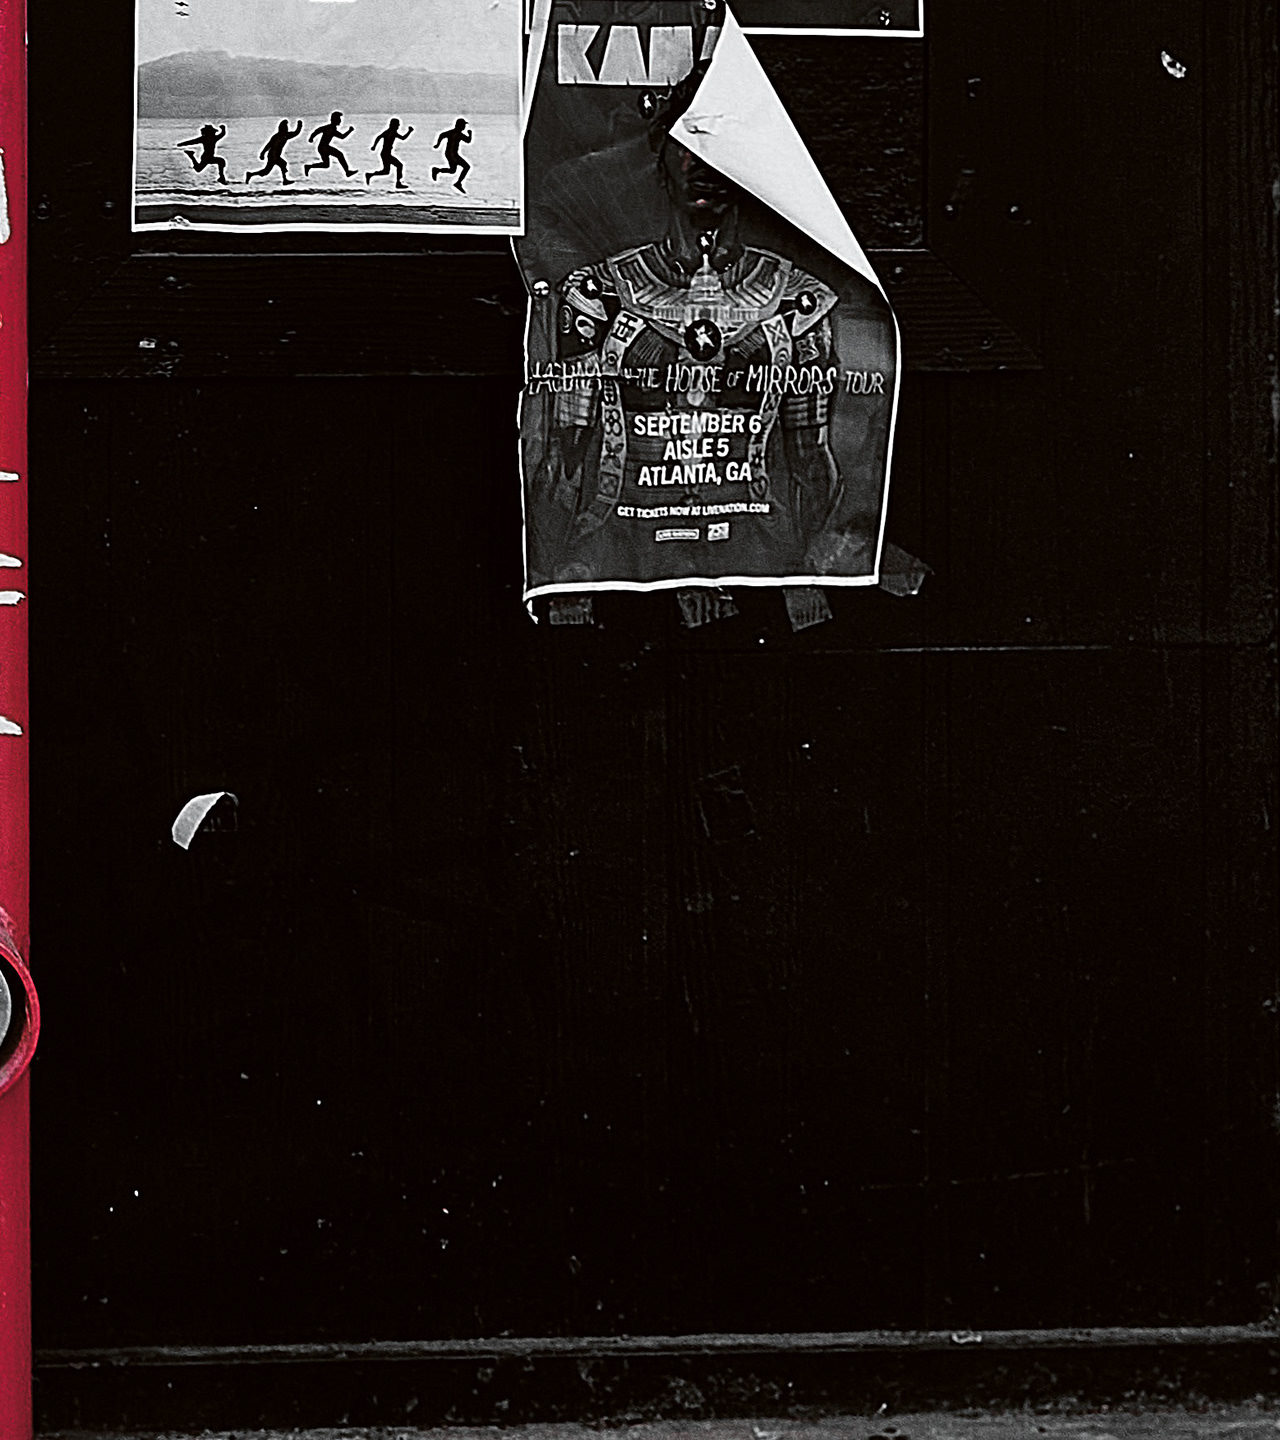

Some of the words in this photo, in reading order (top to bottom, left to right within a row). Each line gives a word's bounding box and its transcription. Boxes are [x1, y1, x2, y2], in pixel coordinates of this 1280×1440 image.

[745, 362, 838, 396] MIRRORS
[842, 369, 887, 396] TOUR
[633, 414, 747, 437] SEPTEMBER
[748, 414, 762, 434] 6
[663, 438, 715, 462] AISLE
[716, 437, 730, 458] 5
[637, 463, 723, 487] ATLANTA,
[725, 462, 753, 483] GA
